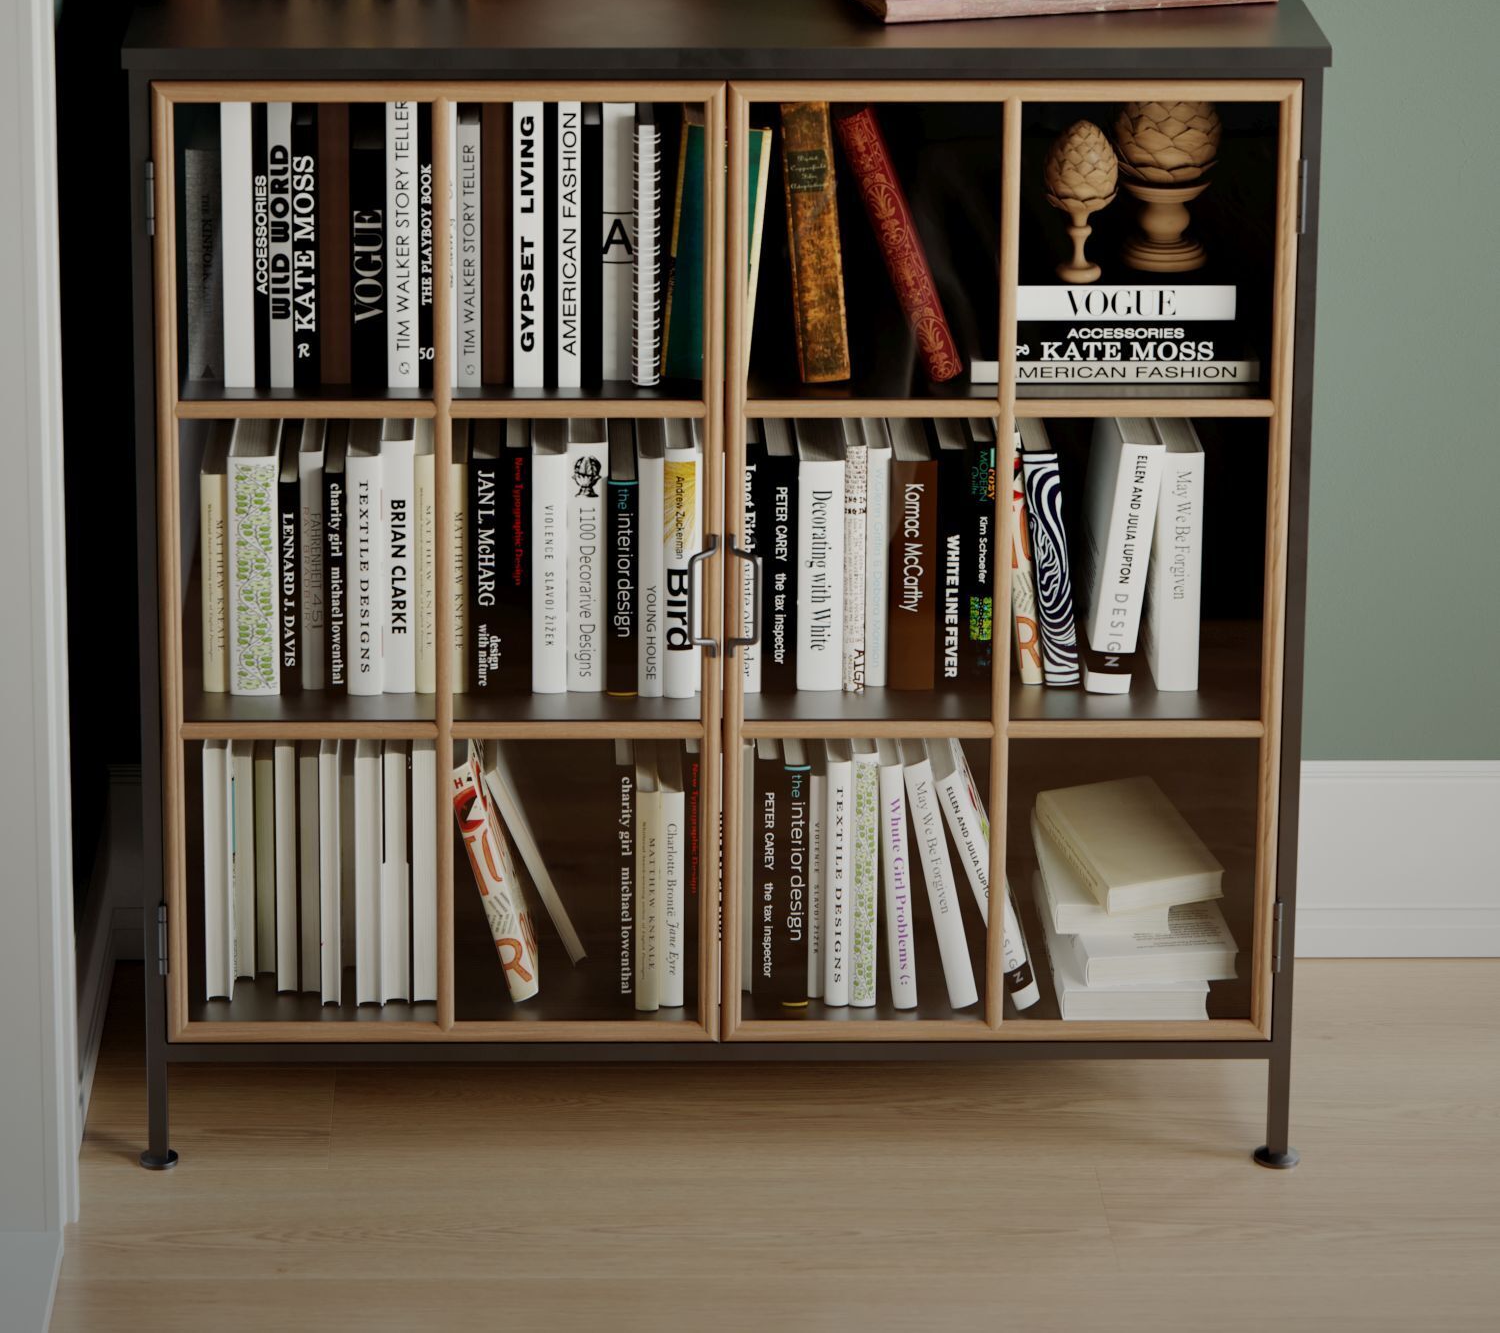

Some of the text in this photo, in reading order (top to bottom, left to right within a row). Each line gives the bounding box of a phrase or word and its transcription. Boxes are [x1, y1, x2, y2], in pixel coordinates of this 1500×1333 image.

[201, 218, 213, 281] KINFOLK
[255, 175, 268, 295] ACCESSORIES
[270, 145, 291, 320] WILD WORLD
[293, 155, 315, 332] KATE MOSS
[353, 209, 384, 324] VOGUE
[395, 102, 410, 351] TIM WALKER STORY TELLER
[421, 164, 432, 306] THE PLAYBOY BOOK
[463, 144, 476, 356] TIM WALKER STORY TELLER
[520, 116, 535, 352] GYPSET LIVING
[562, 112, 577, 356] AMERICAN FASHION
[602, 218, 633, 256] A
[1040, 341, 1214, 361] KATE MOSS
[1066, 290, 1176, 316] VOGUE
[1067, 327, 1185, 340] ACCESSORIES
[1015, 366, 1238, 378] MERICAN FASHION
[477, 470, 496, 607] JAN L. McHARG
[544, 505, 555, 561] VIOLENCE
[579, 506, 596, 541] 1100
[617, 489, 631, 511] the
[675, 476, 686, 560] Andrew Zuckerman
[899, 483, 924, 613] Kormac McCarthy
[977, 516, 988, 535] Kim
[977, 537, 988, 585] Schaefer
[1118, 455, 1148, 585] ELLEN AND JULIA LUPTON
[1170, 470, 1193, 601] May We Be Forgiven
[215, 519, 225, 652] MATTHEW KNEALE
[282, 513, 296, 667] LENNARD J. DAVIS
[310, 513, 323, 629] FAHRENHEIT 451
[327, 483, 344, 685] charity girl michael lowenthal
[359, 479, 370, 674] TEXTILE DESIGNS
[391, 499, 407, 635] BRIAN CLARKE
[454, 512, 464, 651] MATTHEW KNEALE
[666, 568, 693, 651] Bird
[772, 486, 788, 665] PETER CAREY the tax inspector
[805, 490, 833, 652] Decorating with White
[944, 534, 961, 678] WHITE LINE FEVER
[478, 624, 490, 687] with nature
[489, 635, 501, 670] design
[574, 624, 596, 678] Designs
[646, 585, 657, 681] YOUNG HOUSE
[1103, 593, 1129, 668] DESIGN
[791, 774, 804, 798] the
[813, 822, 821, 874] VIOLENCE
[913, 781, 951, 915] May We Be Forgiven
[945, 785, 990, 900] ELLEN AND JULIA LUPTO
[617, 776, 633, 995] charity girl michael lowenthal
[648, 837, 656, 971] MATTHEW KNEALE
[665, 823, 680, 976] Charlotte Brontë Jane Eyre
[761, 792, 775, 978] PETER CAREY the tax inspector
[833, 785, 844, 984] TEXTILE DESIGNS
[892, 857, 907, 892] Girl
[894, 894, 911, 971] Problems
